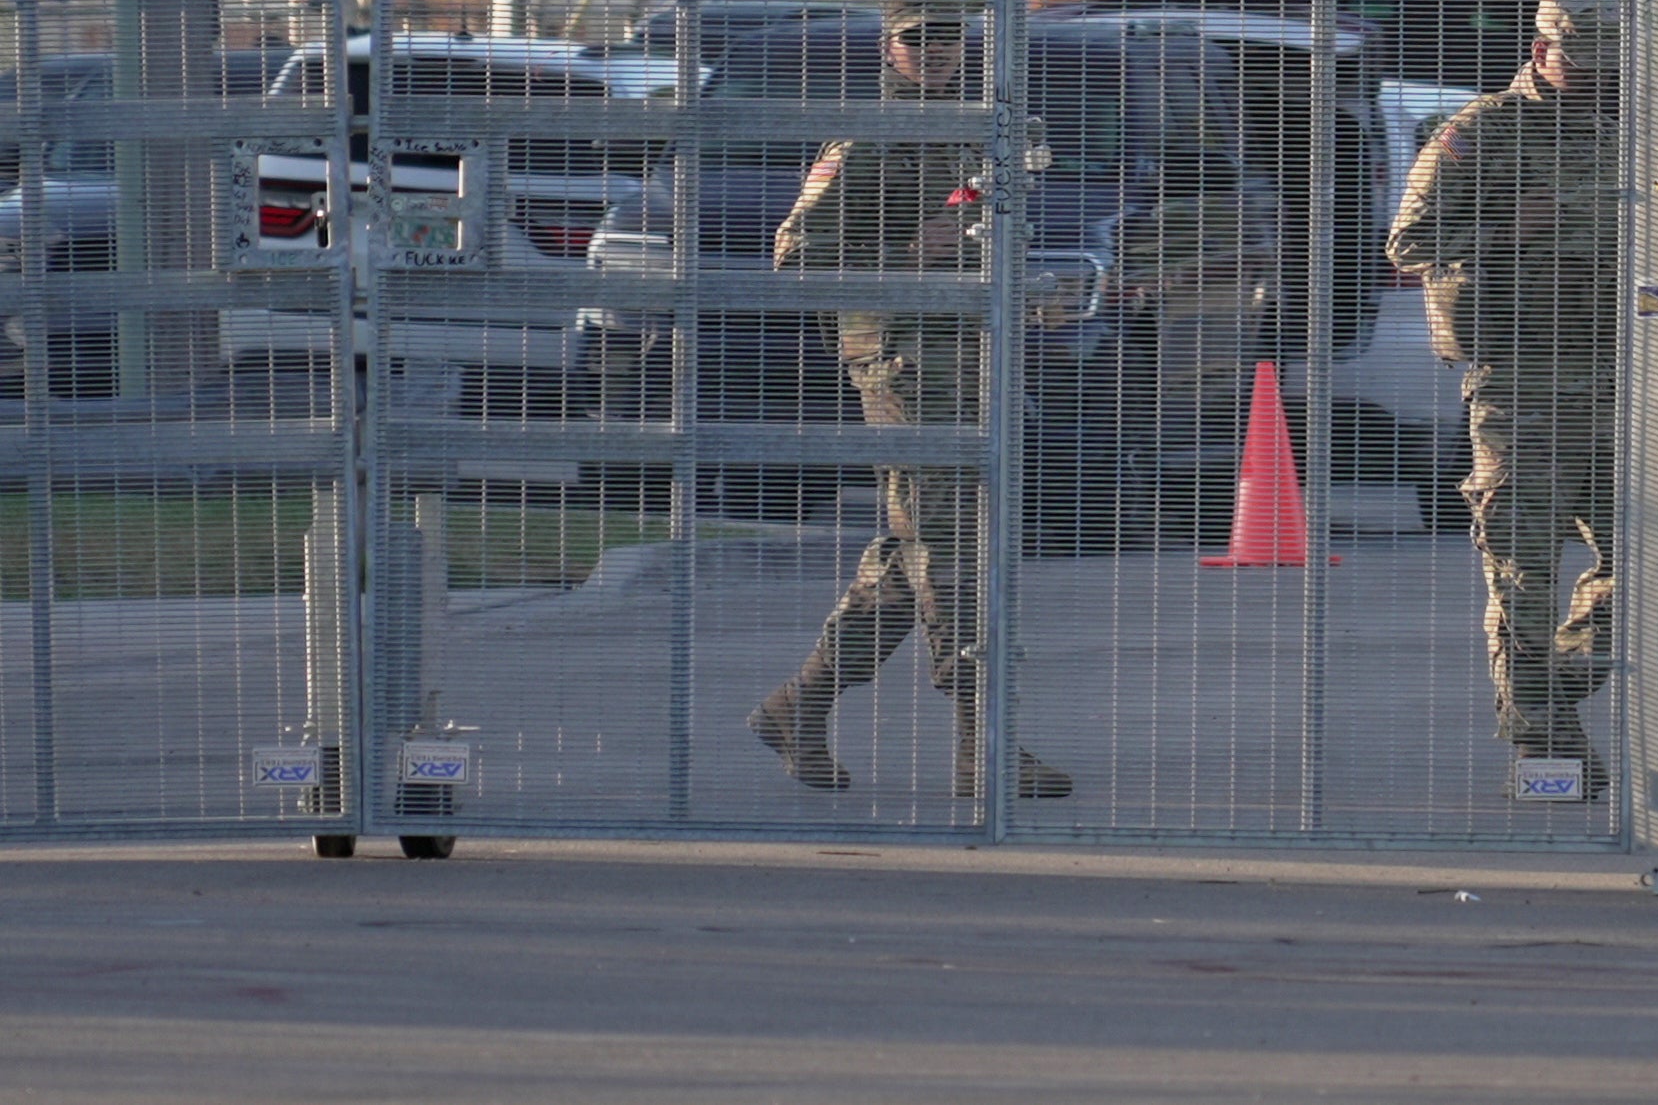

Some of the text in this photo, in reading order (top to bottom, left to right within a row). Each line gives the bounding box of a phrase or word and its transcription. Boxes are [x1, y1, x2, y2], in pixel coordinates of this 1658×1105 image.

[996, 81, 1012, 215] FUCK ICE
[405, 251, 445, 266] FUCK
[261, 767, 313, 781] ARX
[411, 762, 463, 777] ARX
[1523, 780, 1575, 794] ARX
